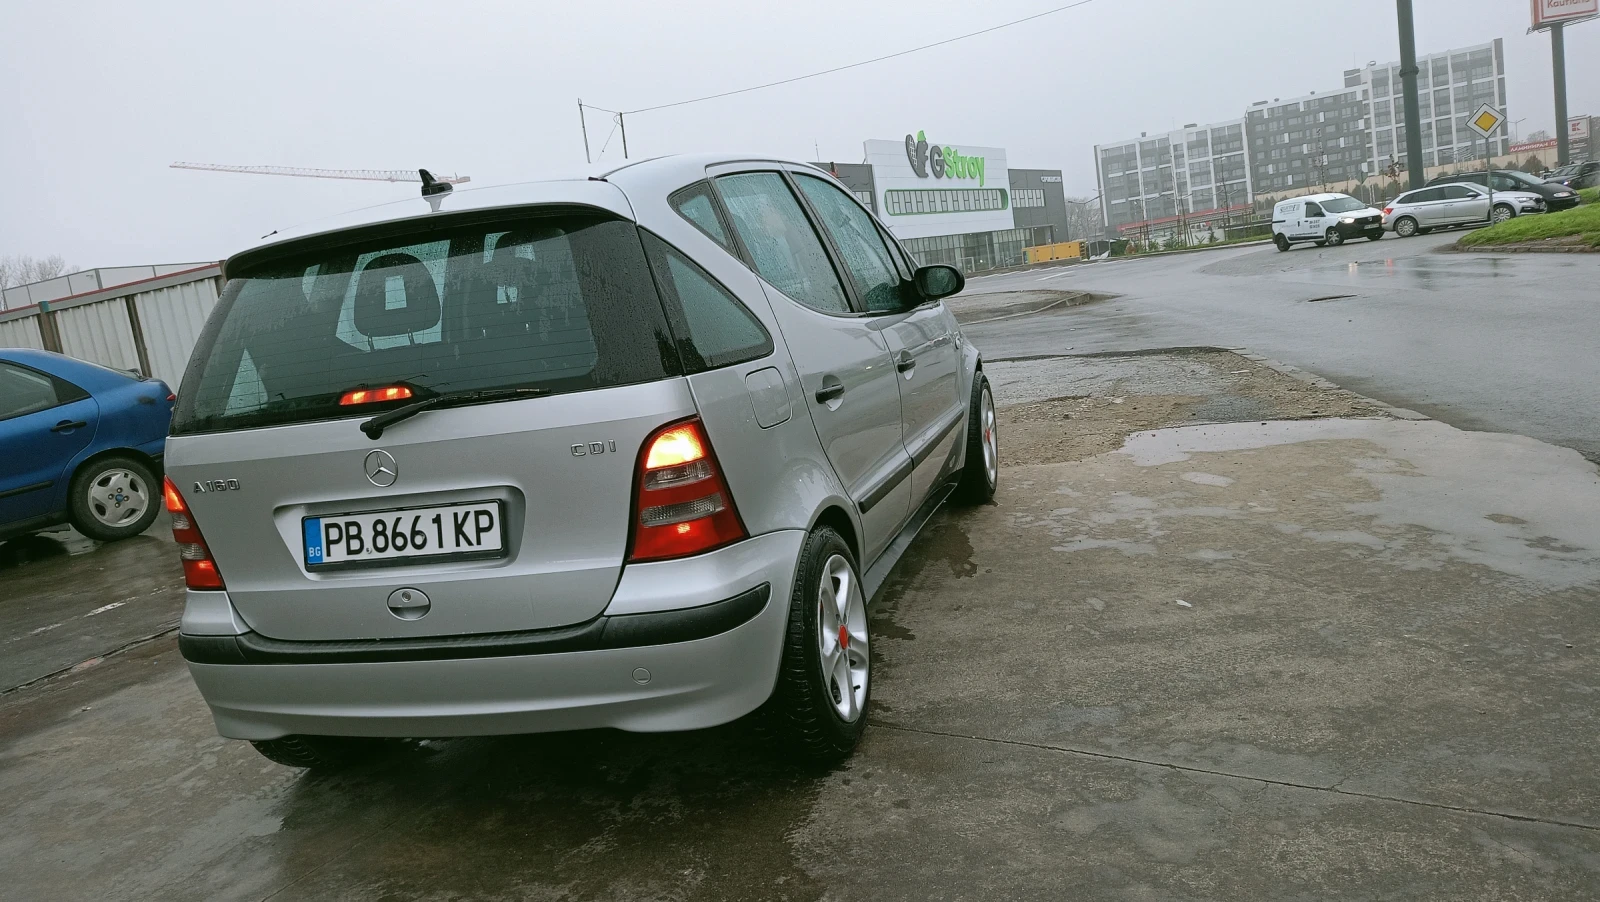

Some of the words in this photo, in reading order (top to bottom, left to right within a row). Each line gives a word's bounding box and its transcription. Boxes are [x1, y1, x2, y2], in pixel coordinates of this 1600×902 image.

[1547, 0, 1592, 8] Kaufla
[930, 145, 984, 187] GStroy
[571, 439, 616, 456] CDI
[193, 478, 240, 493] A160
[309, 547, 321, 557] BG
